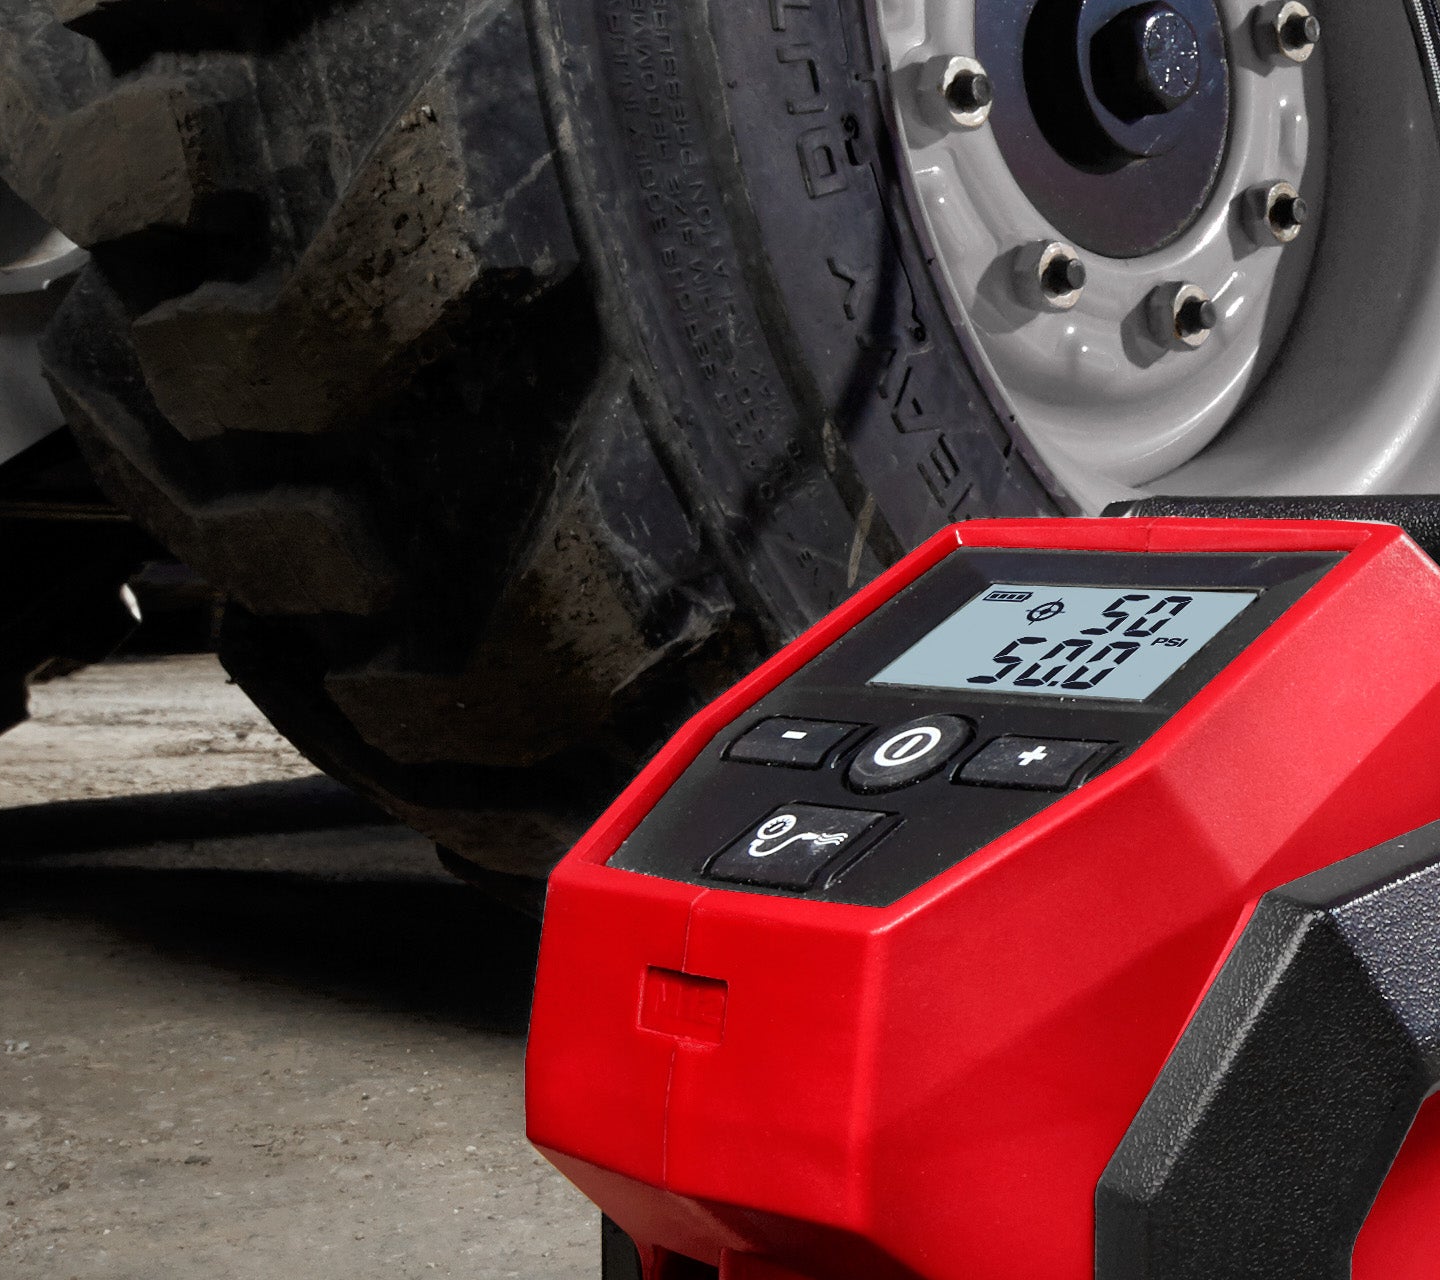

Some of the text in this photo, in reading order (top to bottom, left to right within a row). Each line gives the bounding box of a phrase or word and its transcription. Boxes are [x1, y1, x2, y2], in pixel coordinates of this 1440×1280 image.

[1080, 594, 1195, 638] 50
[966, 635, 1142, 690] 50.0
[1150, 637, 1189, 649] PSI
